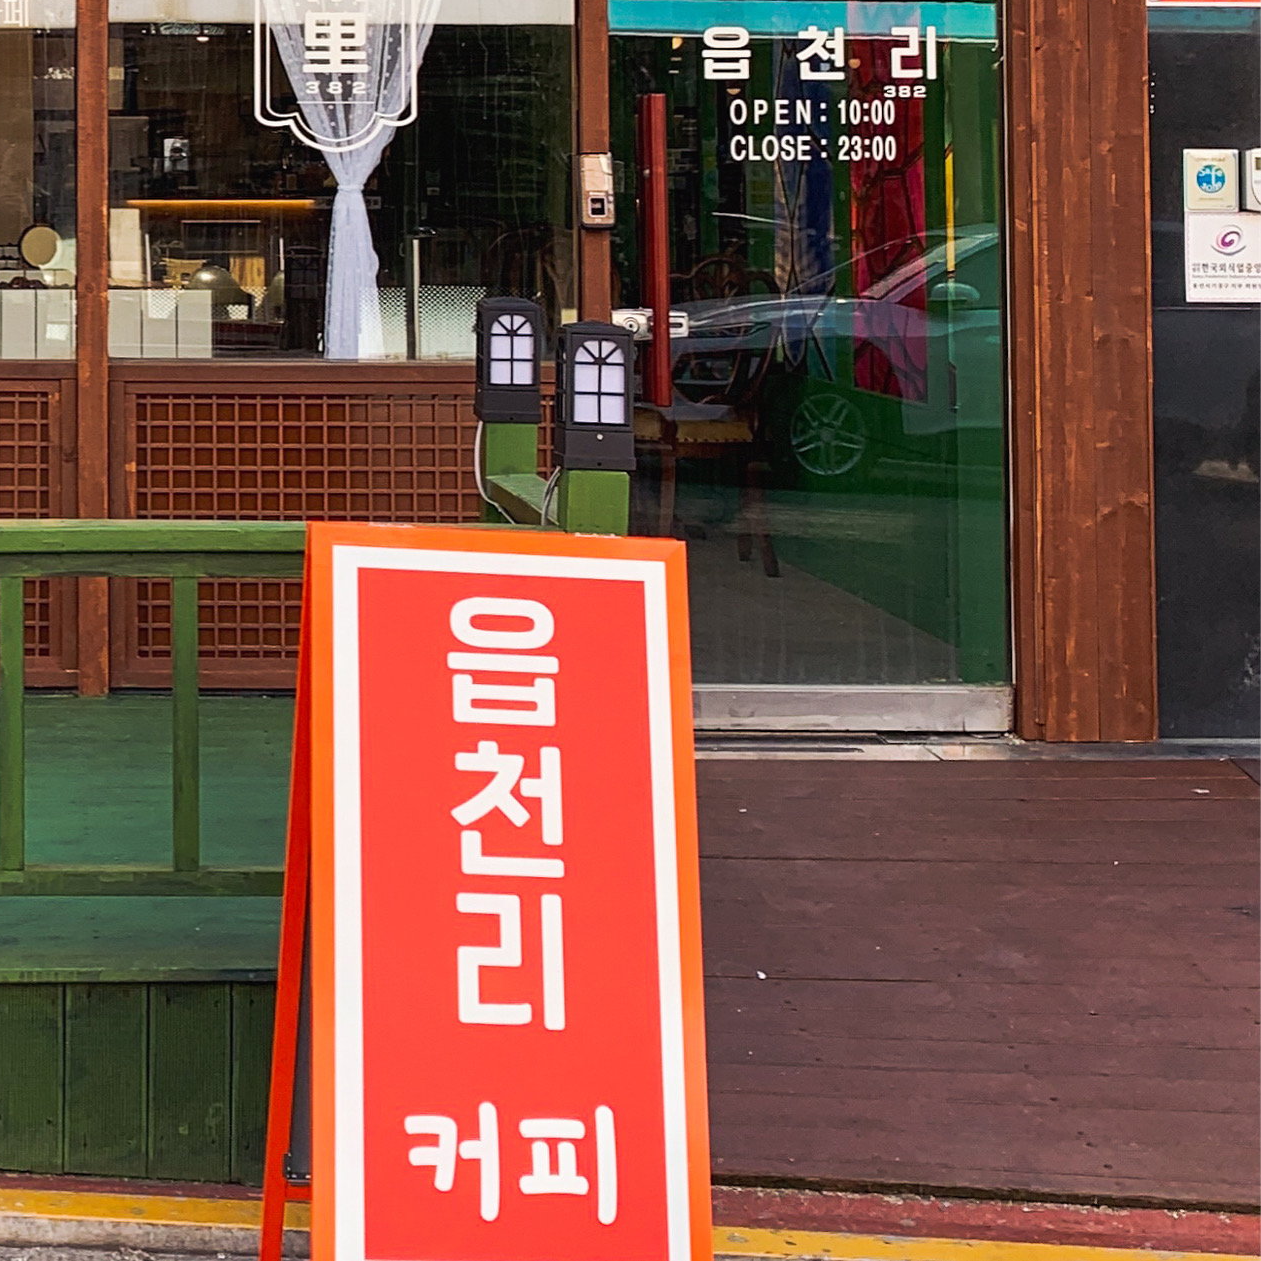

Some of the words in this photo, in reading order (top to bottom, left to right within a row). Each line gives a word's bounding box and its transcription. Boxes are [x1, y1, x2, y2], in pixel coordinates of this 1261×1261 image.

[702, 25, 938, 81] 읍천리
[304, 80, 368, 95] 382
[882, 84, 928, 99] 382
[837, 99, 896, 126] 10:00
[837, 135, 897, 162] 23:00
[446, 595, 567, 1031] 읍천리
[403, 1100, 619, 1226] 커피
